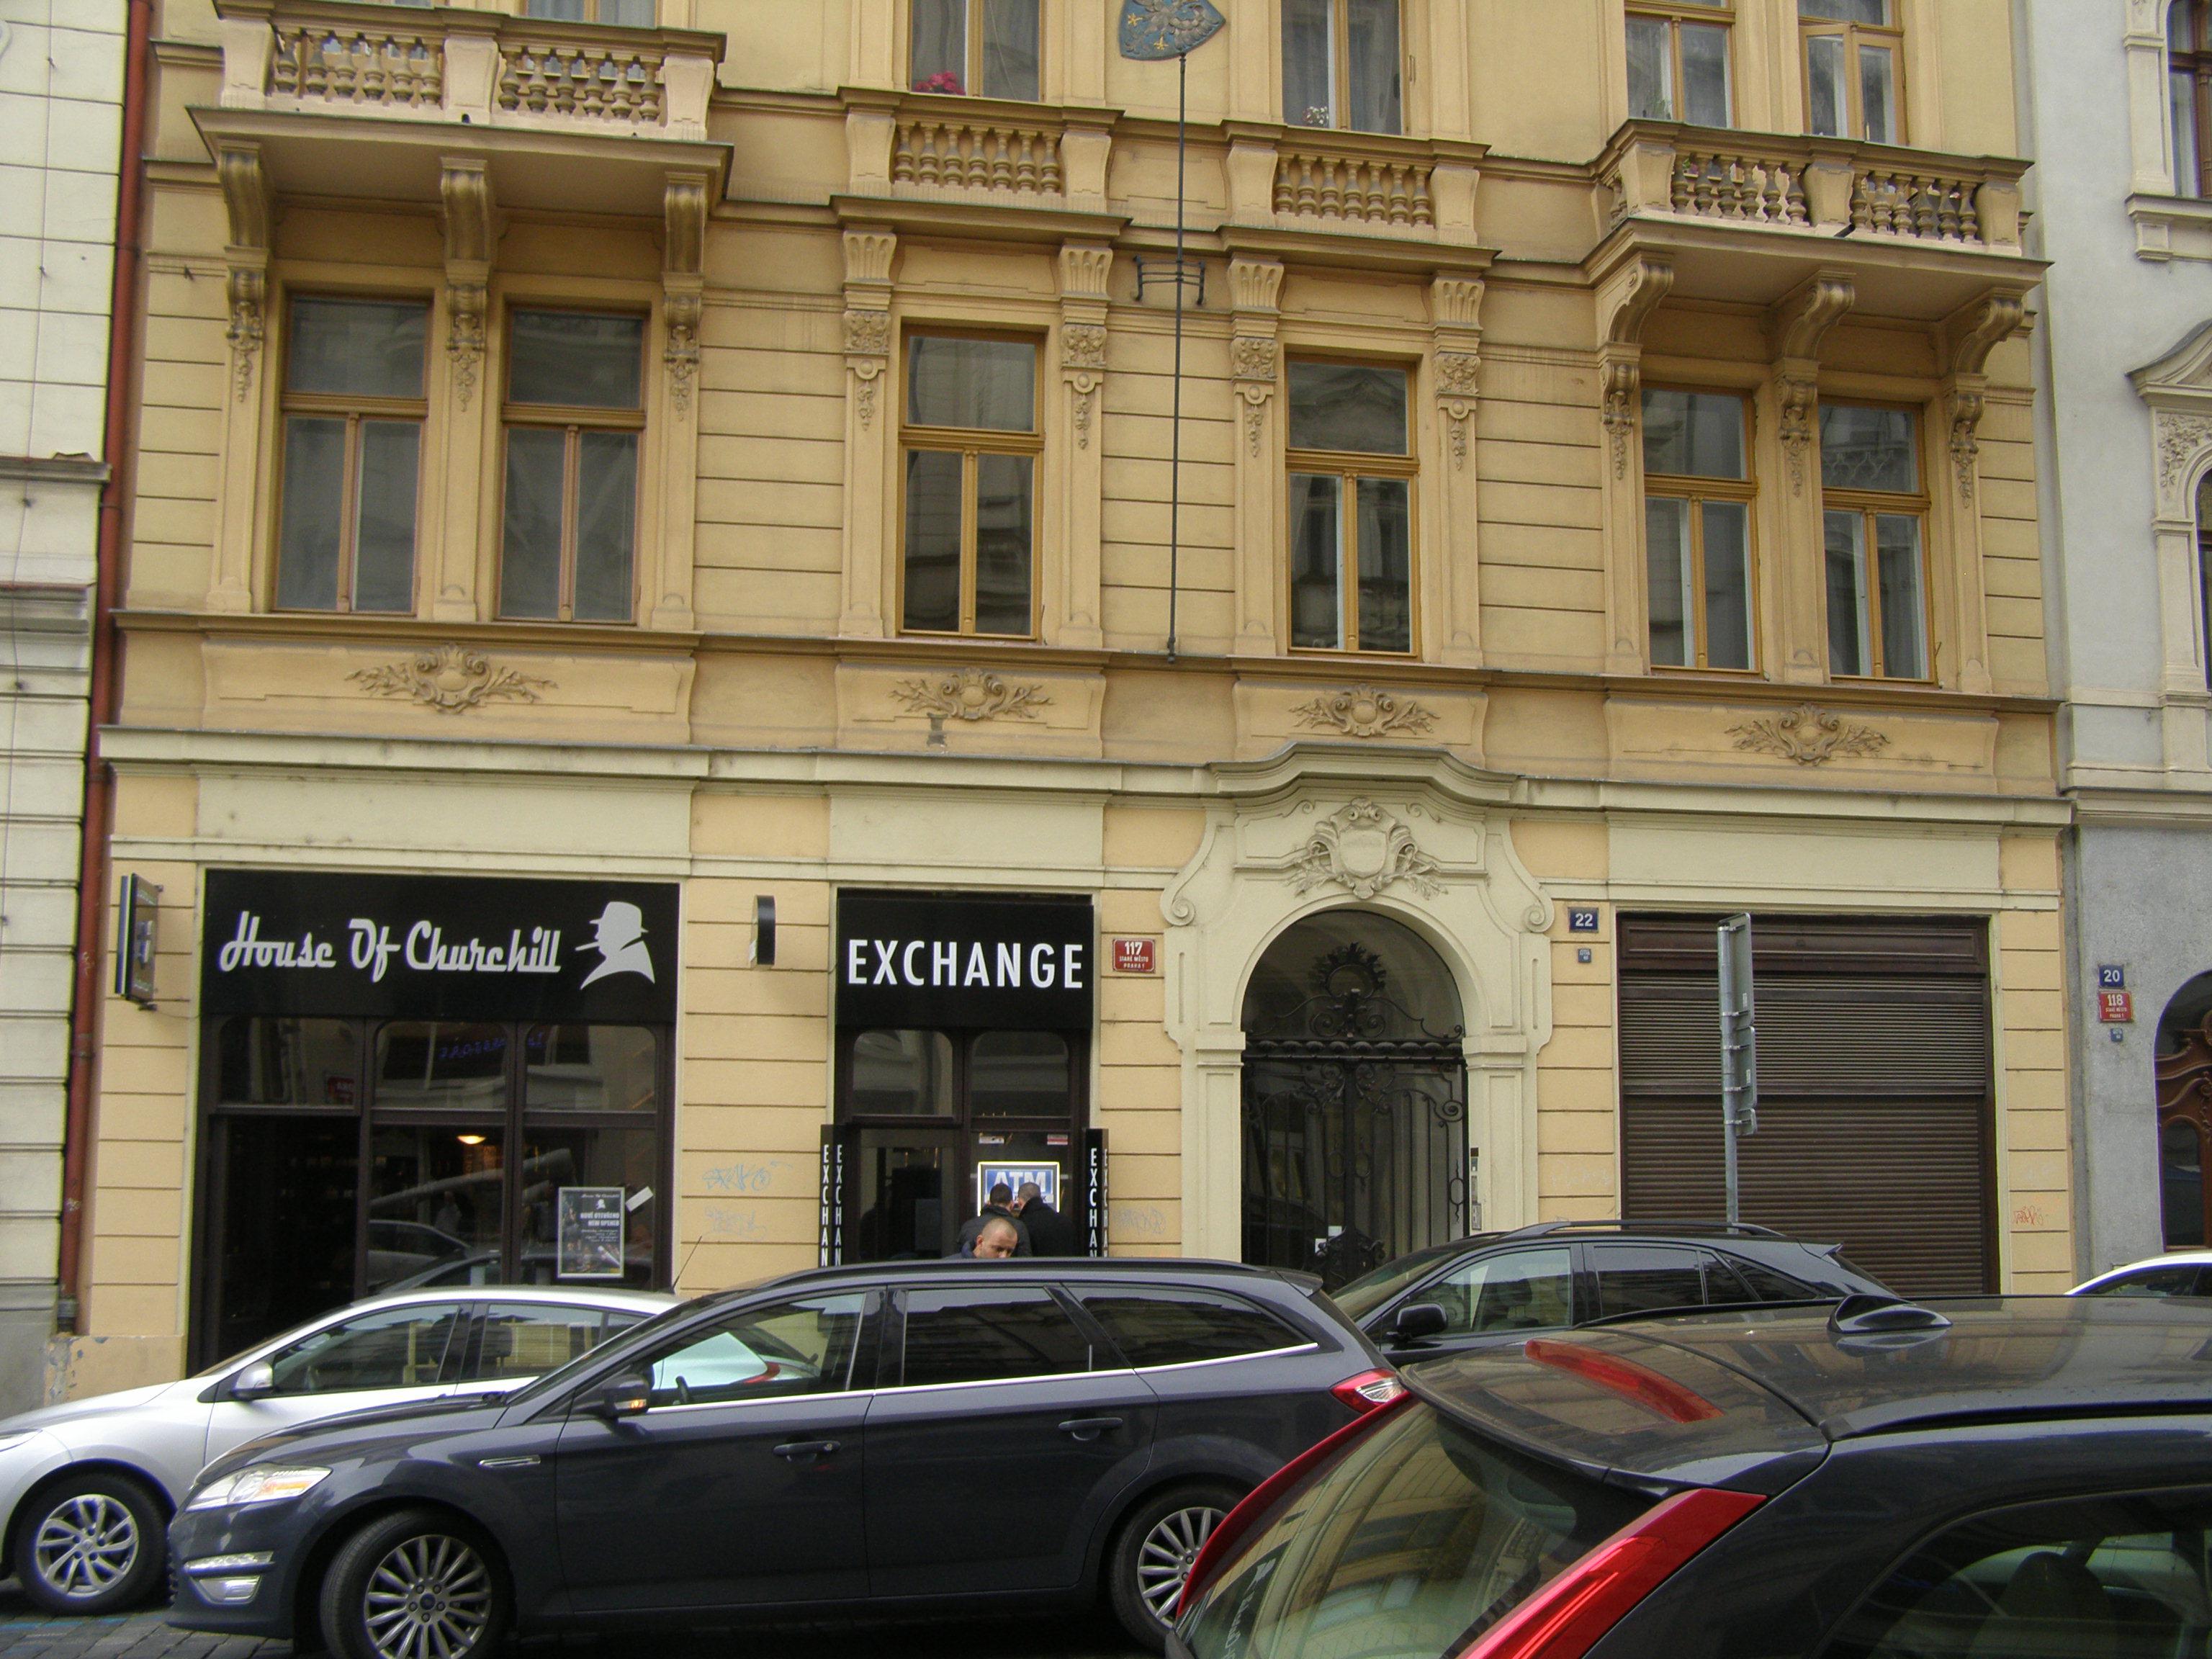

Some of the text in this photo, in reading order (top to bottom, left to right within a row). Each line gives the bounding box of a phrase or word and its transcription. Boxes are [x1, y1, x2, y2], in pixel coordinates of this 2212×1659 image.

[1575, 913, 1593, 927] 22
[219, 911, 562, 983] House Of Churchill
[1125, 942, 1143, 955] 117
[848, 939, 1083, 989] EXCHANGE
[2103, 970, 2121, 983] 20
[2107, 994, 2123, 1007] 118
[994, 1171, 1046, 1192] ATM
